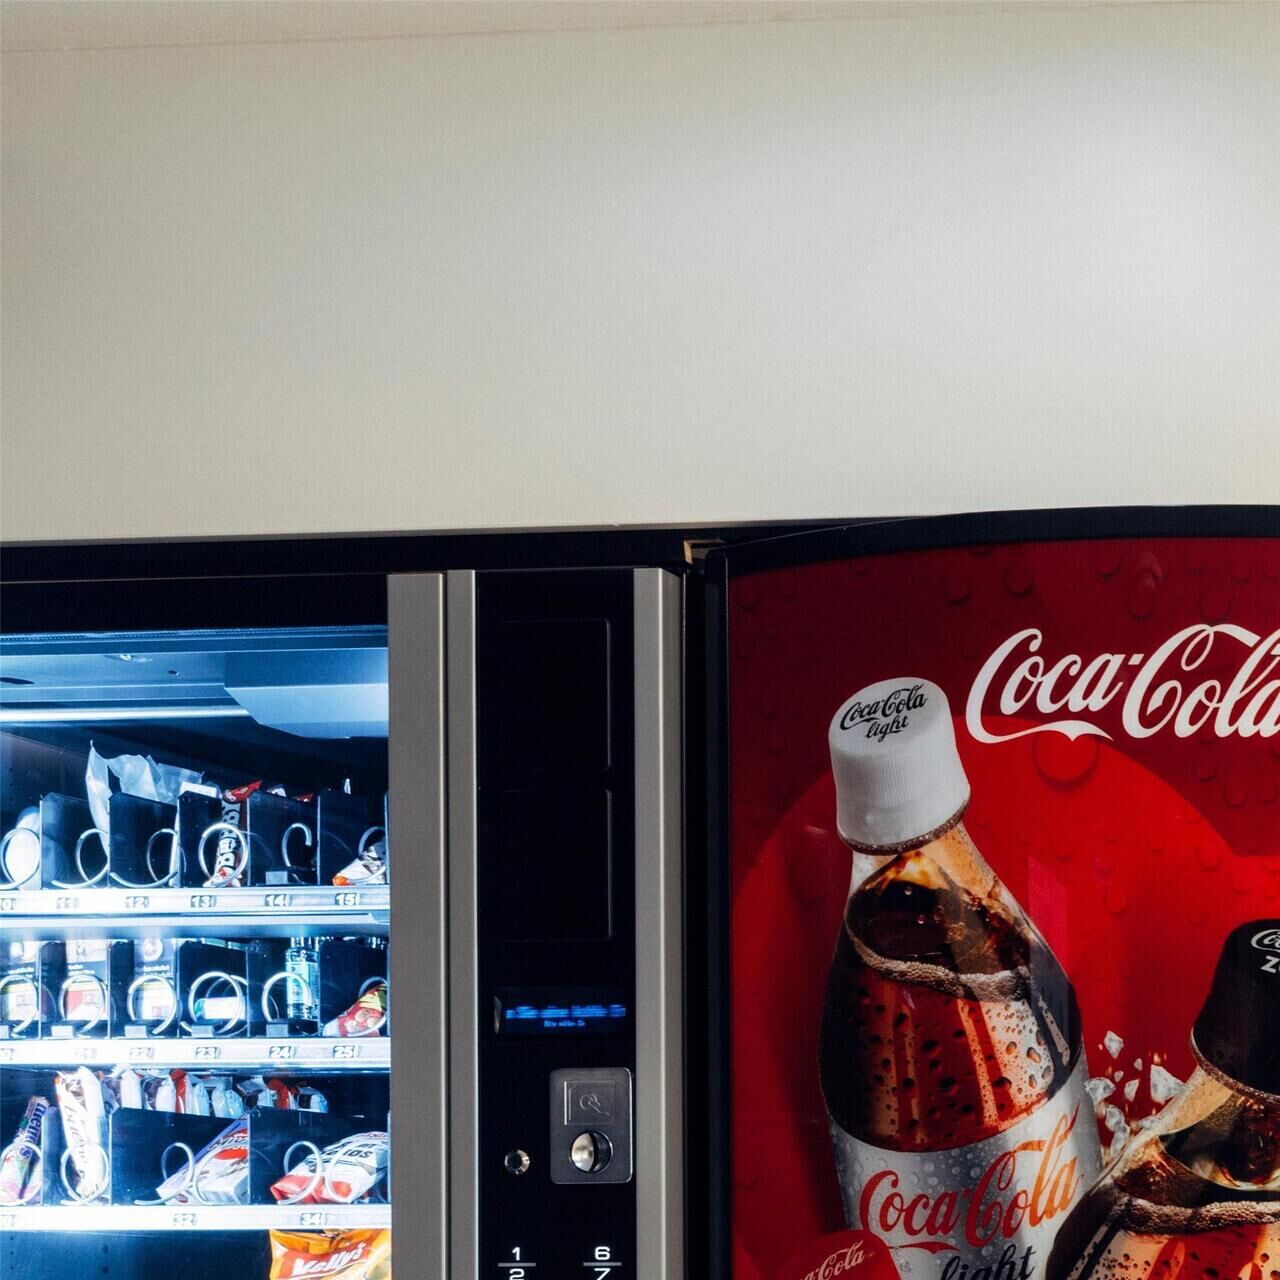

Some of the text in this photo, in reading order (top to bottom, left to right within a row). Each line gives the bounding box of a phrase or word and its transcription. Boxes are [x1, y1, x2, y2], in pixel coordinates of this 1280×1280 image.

[838, 684, 928, 733] Coca-Cola
[866, 714, 909, 743] light
[336, 892, 358, 906] 15
[268, 1046, 291, 1059] 24
[333, 1045, 354, 1058] 25
[859, 1106, 1080, 1250] Coca-Cola
[513, 1247, 521, 1260] 1
[595, 1247, 610, 1260] 6
[595, 1269, 610, 1280] 7
